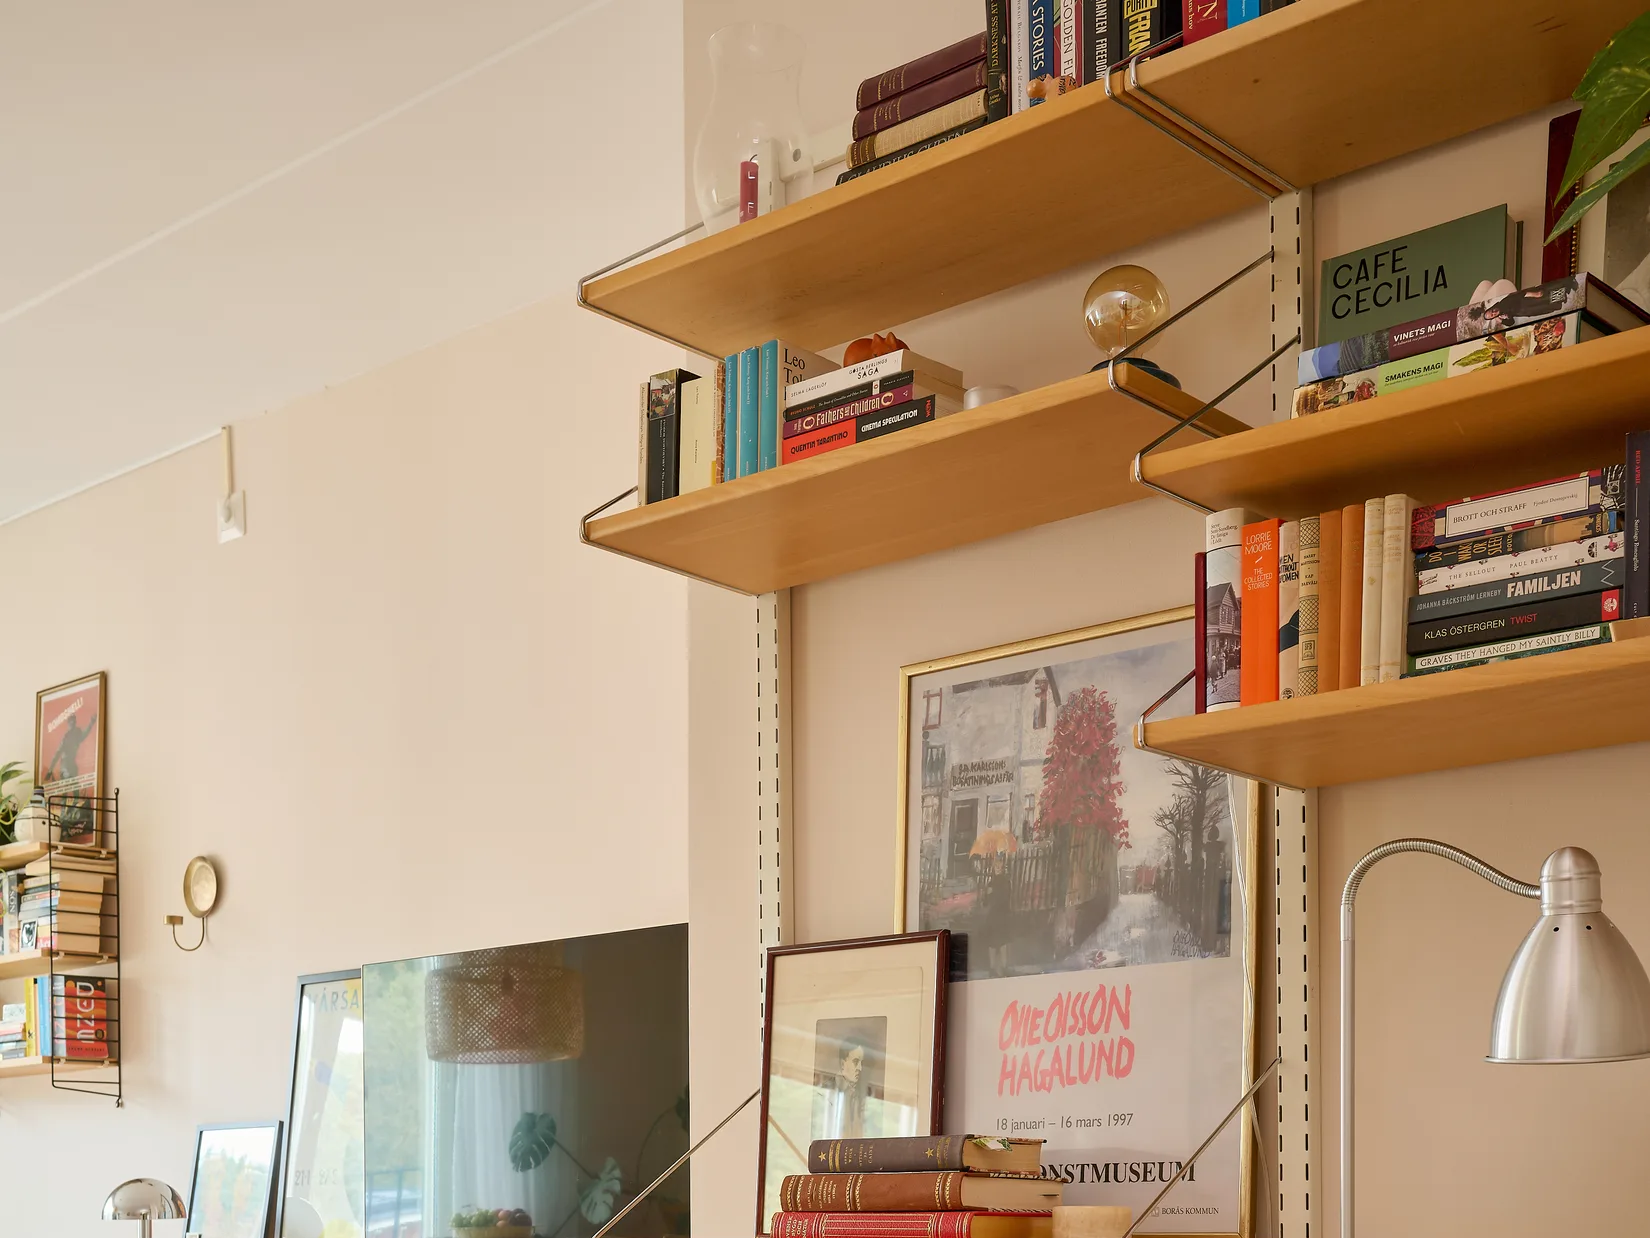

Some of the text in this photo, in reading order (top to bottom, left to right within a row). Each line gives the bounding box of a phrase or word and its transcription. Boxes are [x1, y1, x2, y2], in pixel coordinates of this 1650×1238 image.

[991, 16, 999, 67] DARKNESS
[1032, 6, 1045, 71] STORIES
[1332, 245, 1408, 290] CAFE
[1331, 264, 1449, 320] CECILIA
[1393, 327, 1426, 342] VINETS
[1427, 319, 1451, 333] MAGI
[783, 348, 806, 370] Leo
[848, 358, 888, 375] GÖSTA BERLINGS
[857, 367, 880, 380] SAGA
[1384, 367, 1422, 383] SMAKENS
[1423, 361, 1444, 373] MAGI
[791, 382, 828, 398] SELMA LAGERLÖF
[816, 407, 844, 428] Fathers
[850, 396, 880, 416] Children
[861, 409, 918, 433] CINEMA SPECULATION
[790, 431, 848, 455] QUENTIN TARANTINO
[1452, 511, 1478, 524] BROTT
[1479, 508, 1498, 519] OCH
[1498, 503, 1527, 515] STRAFF
[1244, 541, 1273, 555] MOORE
[1246, 531, 1272, 546] LORRIE
[1429, 541, 1487, 563] DO OR
[1253, 567, 1264, 575] THE
[1465, 566, 1497, 578] SELLOUT
[1509, 560, 1528, 569] PAUL
[1530, 554, 1559, 565] BEATTY
[1244, 572, 1273, 585] COLLECTED
[1247, 580, 1270, 591] STORIES
[1416, 570, 1581, 611] JOHANNA BÄCKSTRÖM LERNEBY FAMILJEN
[1424, 613, 1538, 640] KLAS ÖSTERGREN TWIST
[1420, 628, 1596, 667] GRAVES THEY HANGED MY SAINTLY BILLY
[998, 1035, 1135, 1098] HAGALUND
[996, 1113, 1134, 1134] 18 januari 16 mars 1997
[1161, 1205, 1219, 1215] BORÅS KOMMUN
